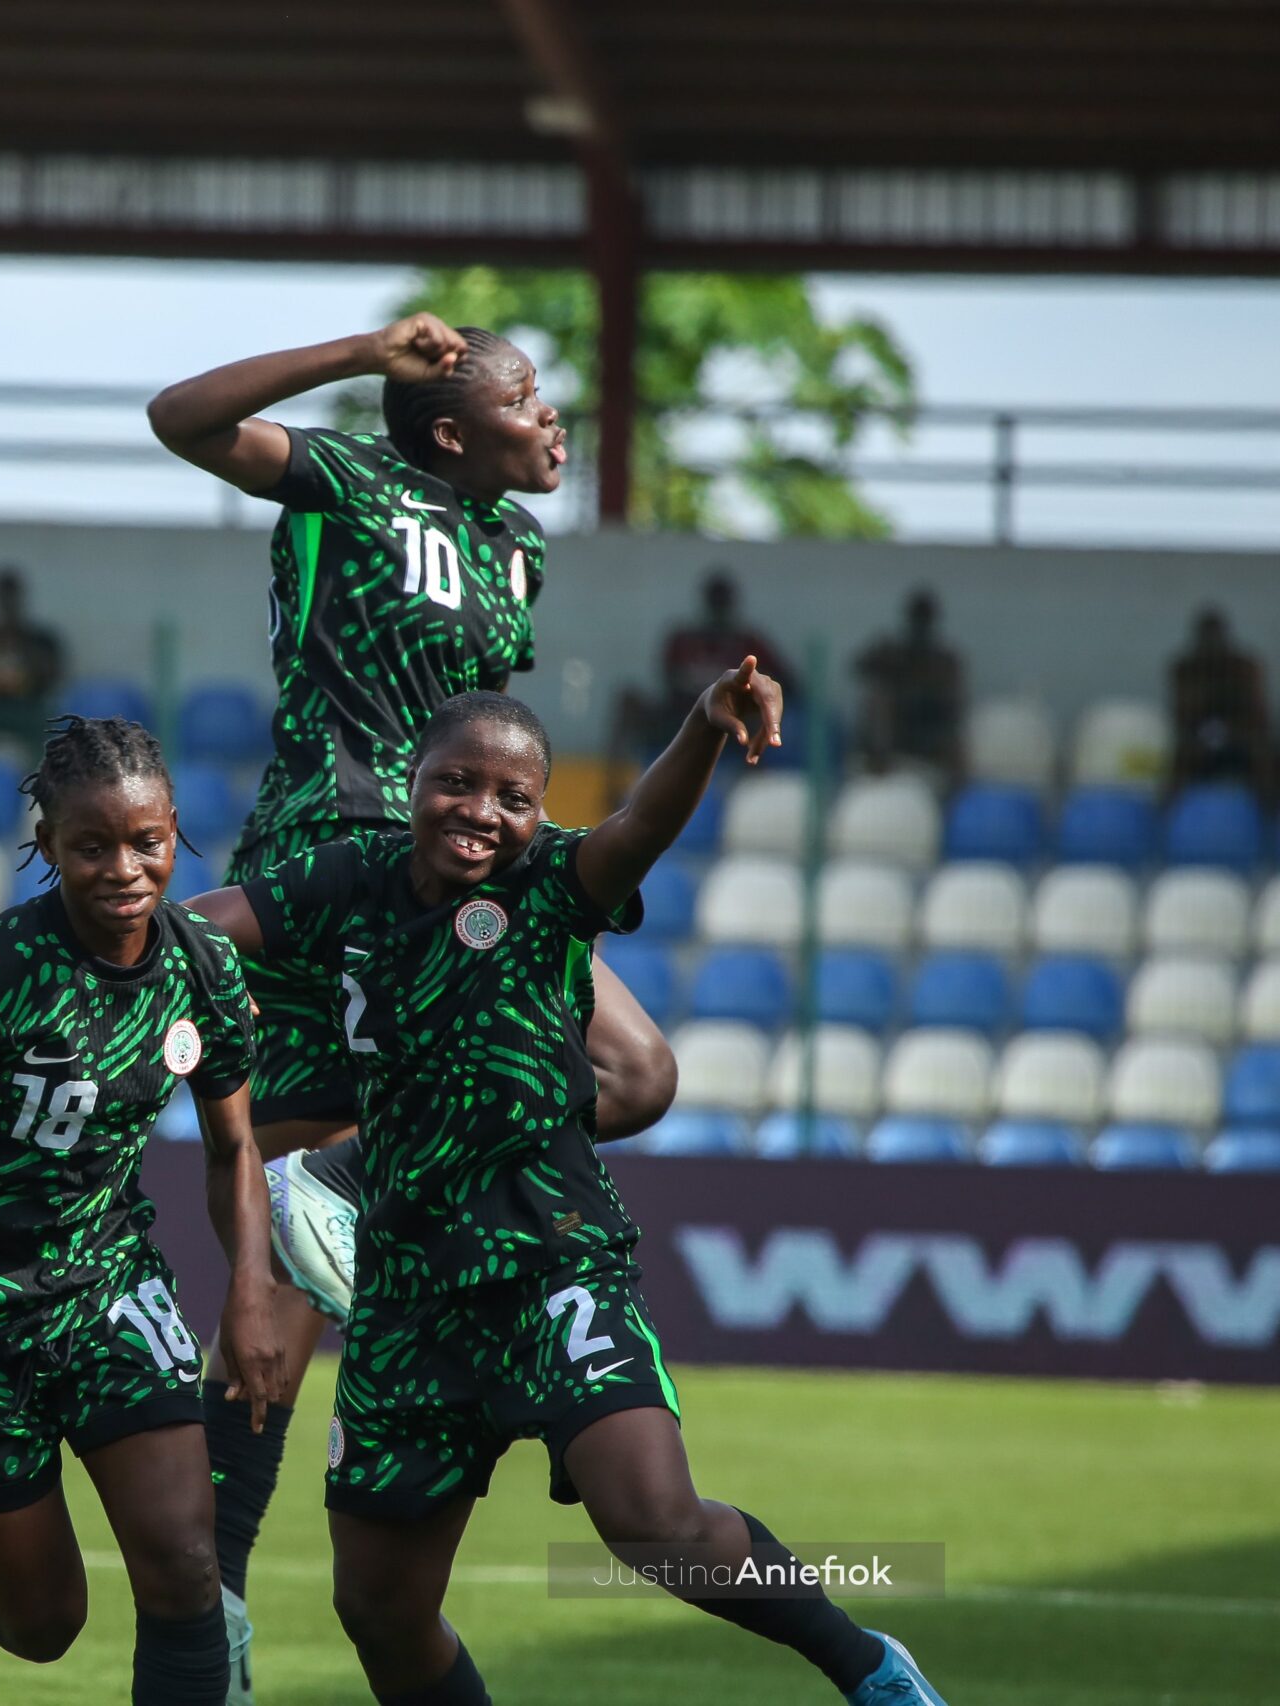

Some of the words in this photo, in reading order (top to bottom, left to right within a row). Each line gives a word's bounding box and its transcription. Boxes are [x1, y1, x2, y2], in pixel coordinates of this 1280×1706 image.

[391, 516, 461, 610] 10
[458, 902, 484, 921] FOOTBALL
[342, 970, 378, 1052] 2
[11, 1073, 99, 1150] 18
[107, 1278, 197, 1371] 18
[546, 1285, 615, 1363] 2
